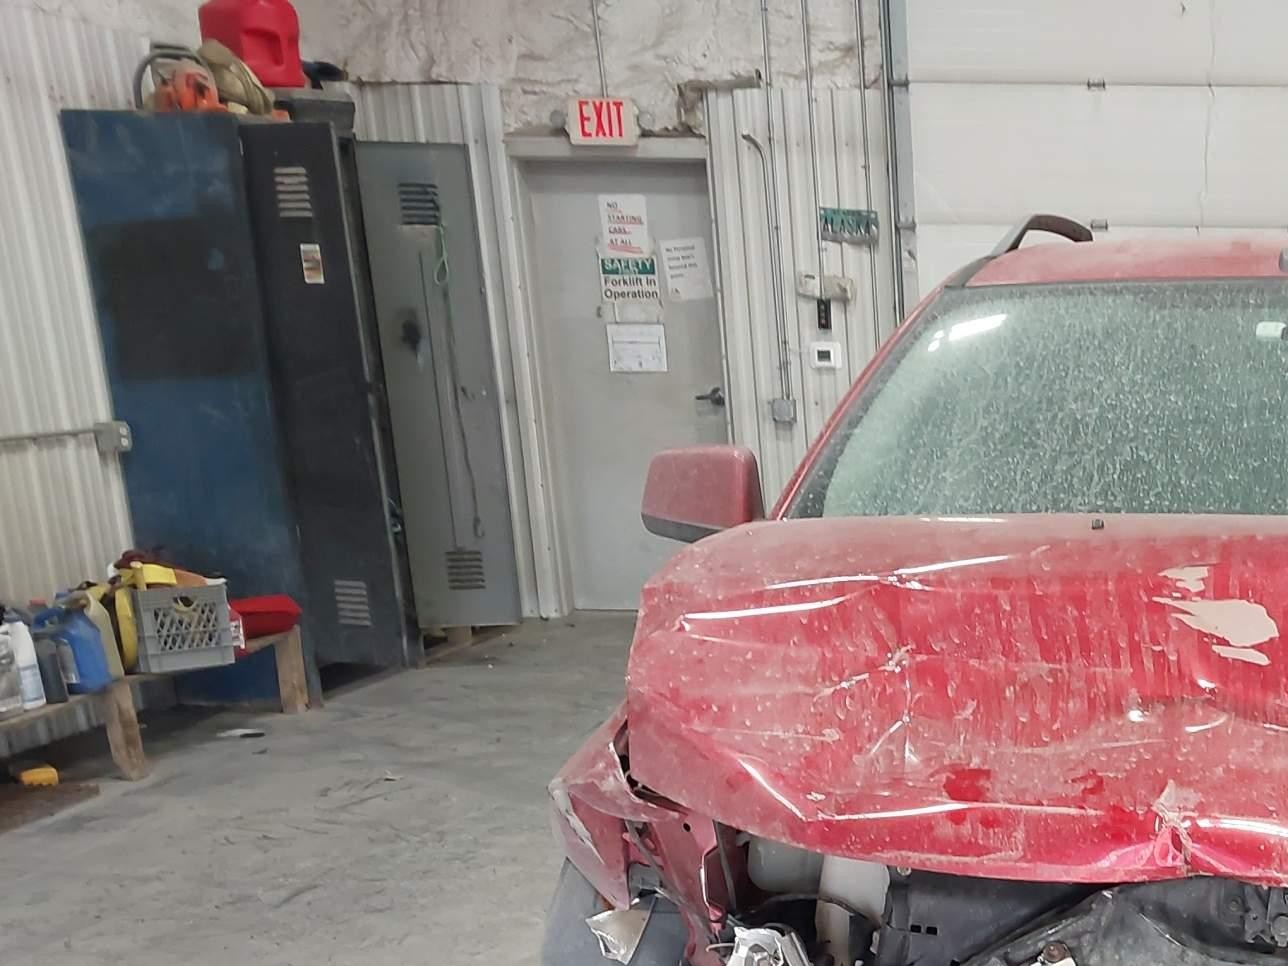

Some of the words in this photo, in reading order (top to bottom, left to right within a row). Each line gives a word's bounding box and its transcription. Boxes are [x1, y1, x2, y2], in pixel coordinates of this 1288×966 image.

[578, 101, 623, 137] EXIT
[606, 201, 618, 209] NO
[822, 216, 871, 237] ALASKA
[603, 259, 653, 270] SAFETY
[604, 277, 643, 288] Forklift
[646, 277, 657, 287] In
[604, 289, 659, 300] Operation
